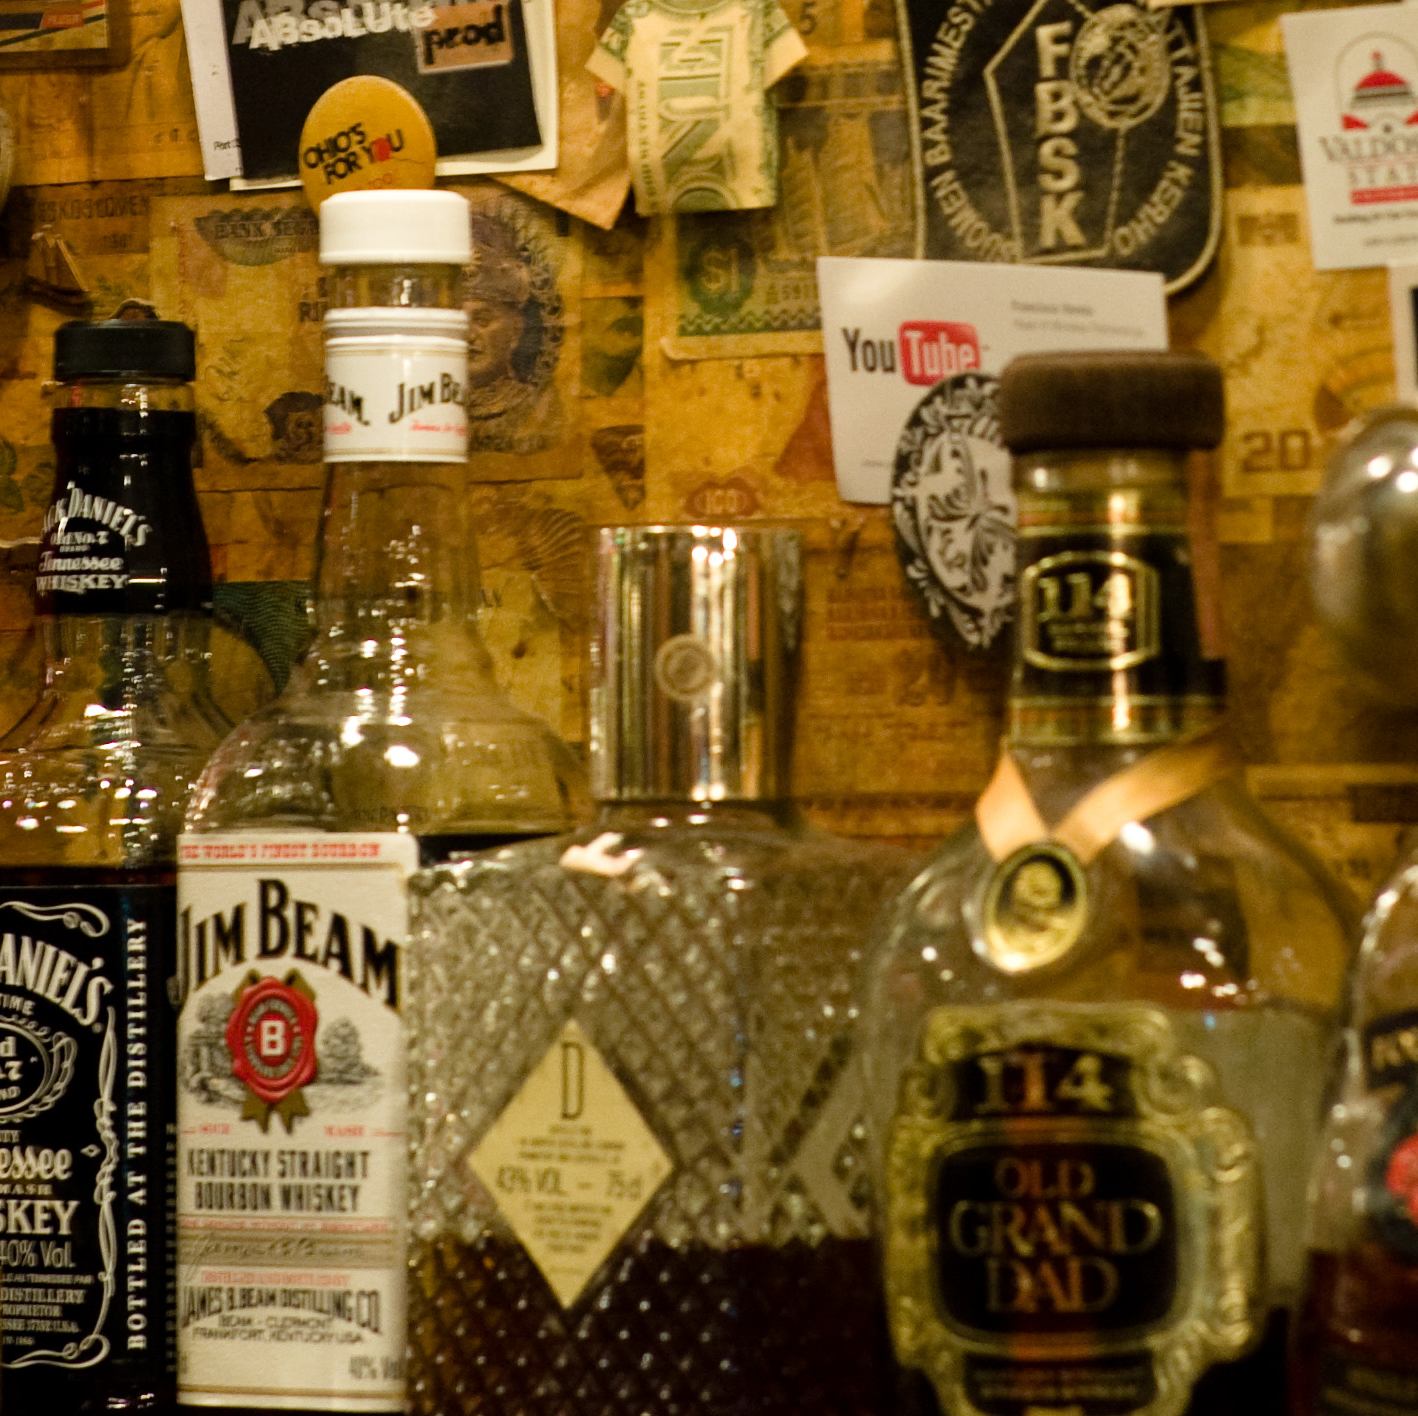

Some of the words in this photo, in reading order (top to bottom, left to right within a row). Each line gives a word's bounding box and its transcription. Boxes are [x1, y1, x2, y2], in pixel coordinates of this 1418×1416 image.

[322, 148, 362, 185] FOR
[1114, 160, 1195, 256] KERHO
[388, 380, 435, 425] JIM
[1240, 427, 1312, 475] 20
[35, 573, 130, 592] WHISKEY
[177, 901, 247, 1014] JIM
[256, 877, 401, 1017] BEAM
[126, 918, 149, 1088] DISTILLERY
[260, 1019, 286, 1058] B
[976, 1053, 1114, 1113] 114
[126, 1098, 149, 1156] THE
[187, 1147, 271, 1178] KENTUCKY
[277, 1149, 371, 1180] STRAIGHT
[994, 1157, 1097, 1200] OLD
[126, 1182, 149, 1210] AT
[278, 1183, 361, 1213] WHISKEY
[948, 1198, 1164, 1257] GRAND
[126, 1218, 149, 1352] BOTTLED
[985, 1255, 1120, 1314] DAD
